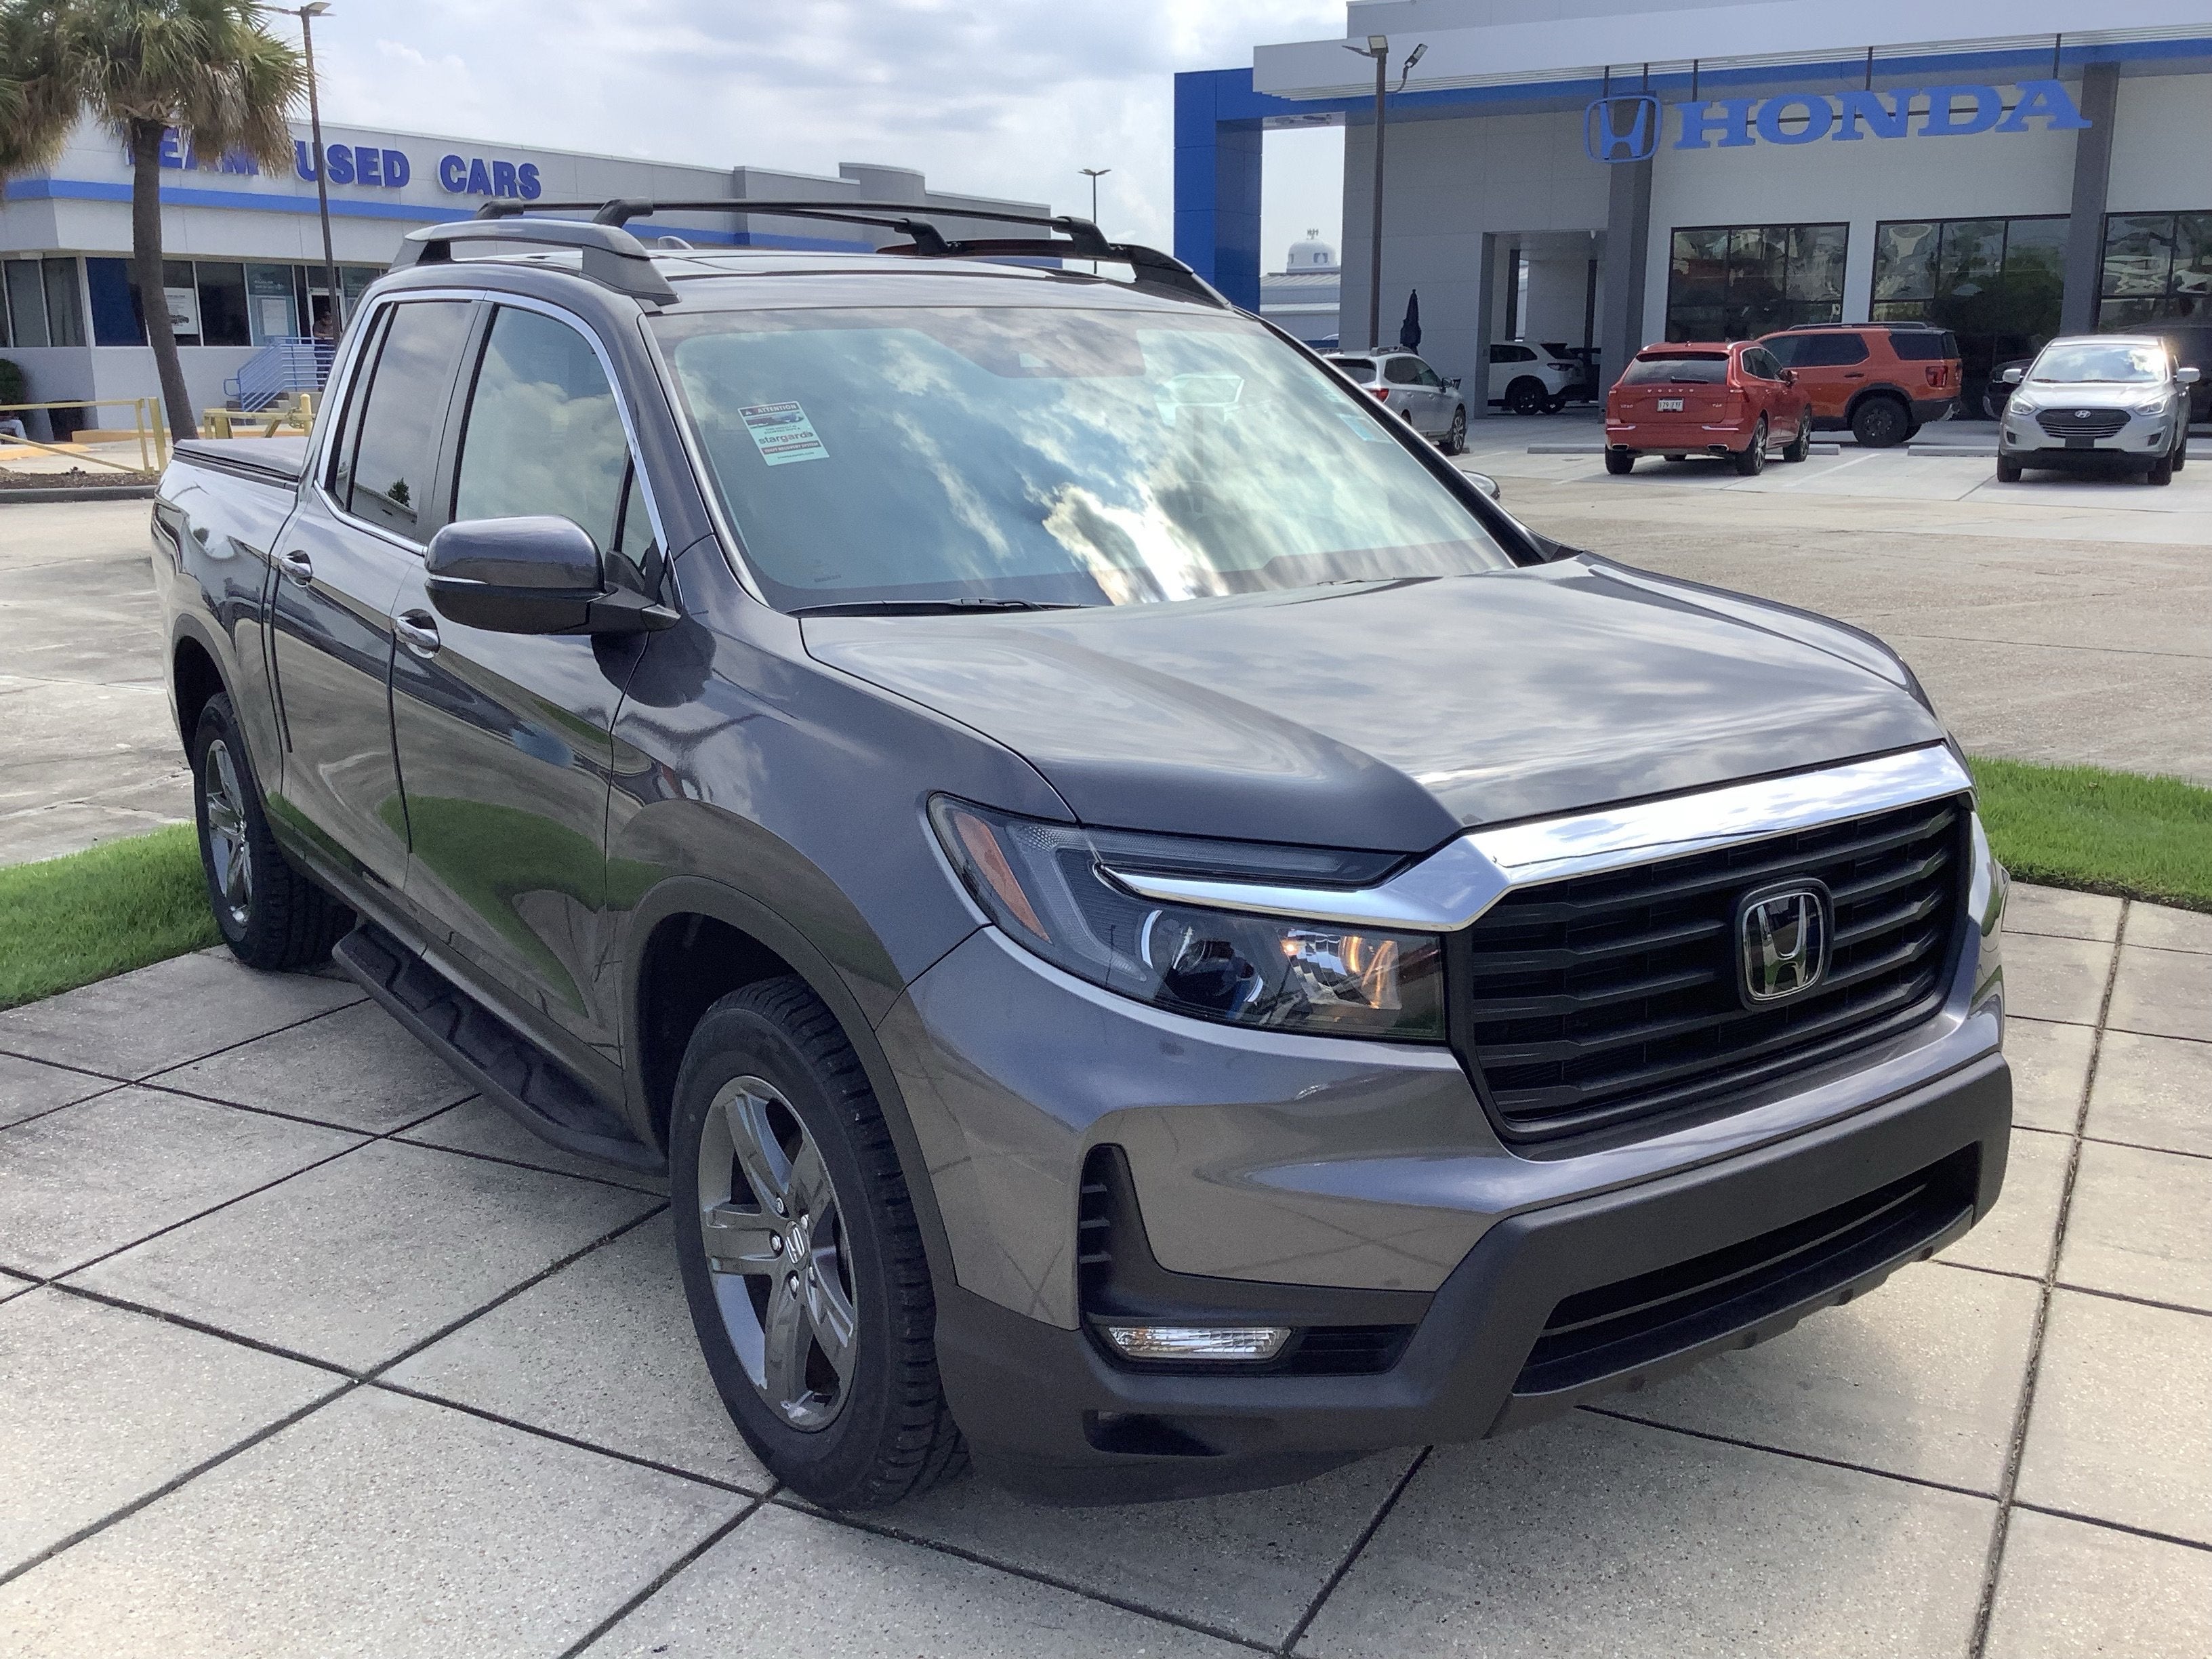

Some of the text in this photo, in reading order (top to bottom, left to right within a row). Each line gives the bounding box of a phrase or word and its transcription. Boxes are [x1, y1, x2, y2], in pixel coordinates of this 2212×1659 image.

[1674, 79, 2092, 150] HONDA
[294, 140, 410, 188] USED
[440, 154, 542, 200] CARS
[758, 404, 796, 413] ATTENTION
